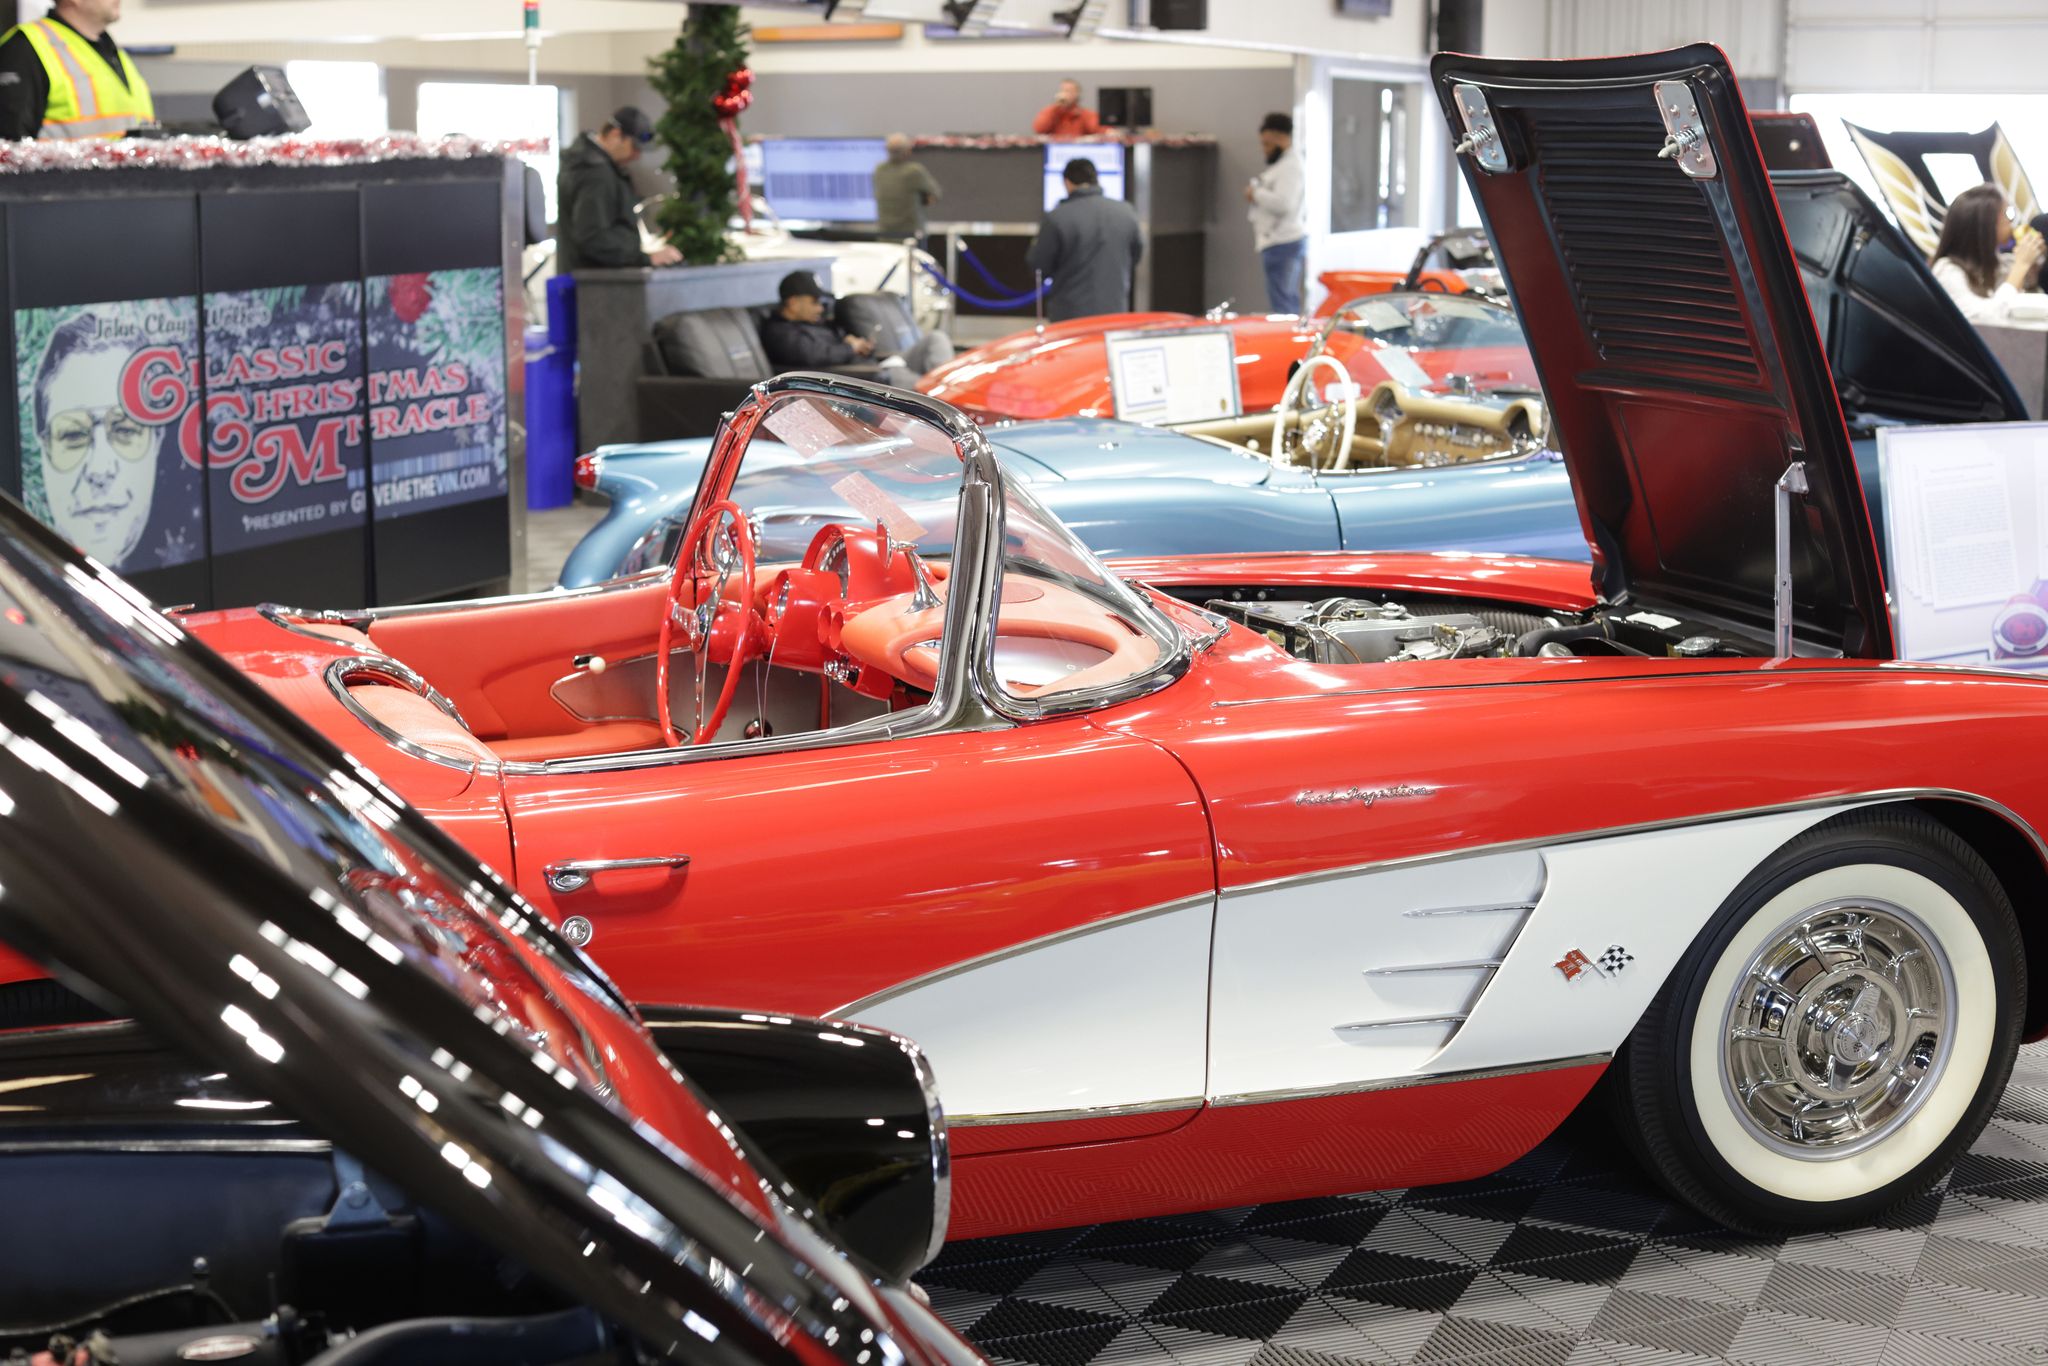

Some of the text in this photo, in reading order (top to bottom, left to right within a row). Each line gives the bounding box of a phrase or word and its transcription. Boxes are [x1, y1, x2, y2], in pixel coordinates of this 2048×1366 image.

[95, 316, 136, 340] John
[144, 313, 187, 337] Clay
[120, 339, 347, 425] CLASSIC
[178, 362, 469, 468] CHRISTMAS
[230, 393, 491, 502] MIRACLE
[242, 503, 325, 532] PRESENTED
[329, 500, 348, 517] BY
